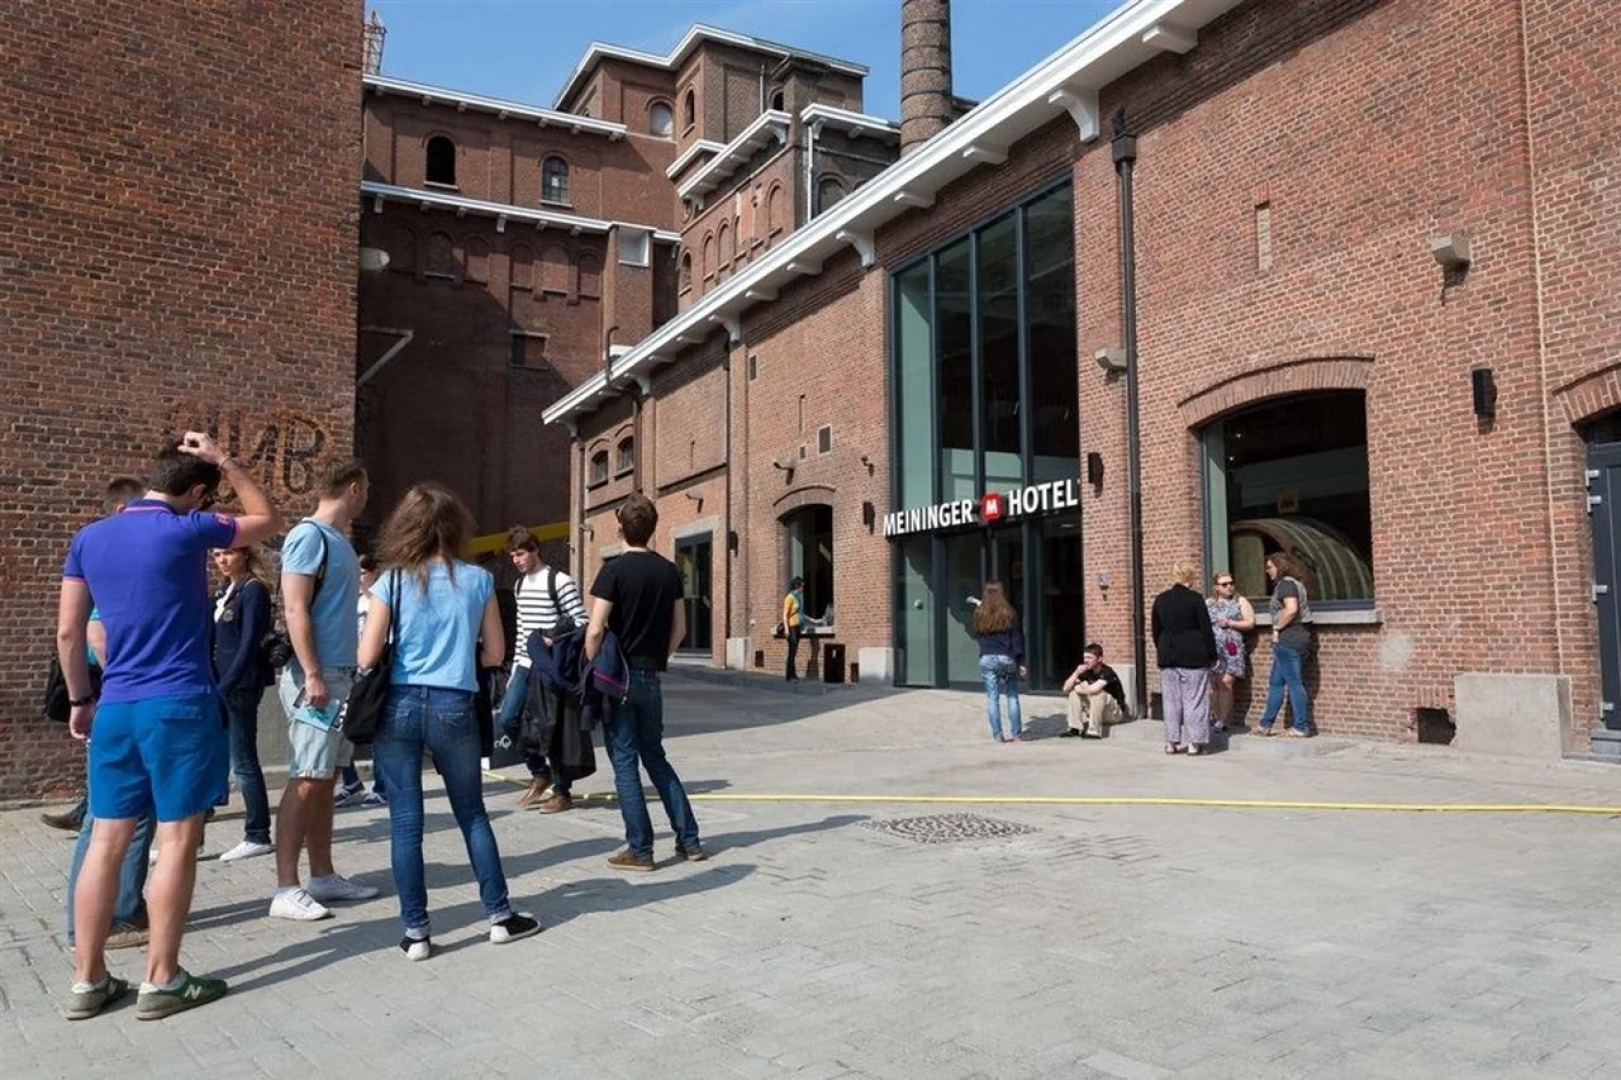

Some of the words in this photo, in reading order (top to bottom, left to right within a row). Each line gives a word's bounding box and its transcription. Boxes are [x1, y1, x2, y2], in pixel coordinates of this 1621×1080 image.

[883, 499, 974, 536] MEININGER
[1008, 479, 1080, 516] HOTEL
[184, 984, 202, 1000] N
